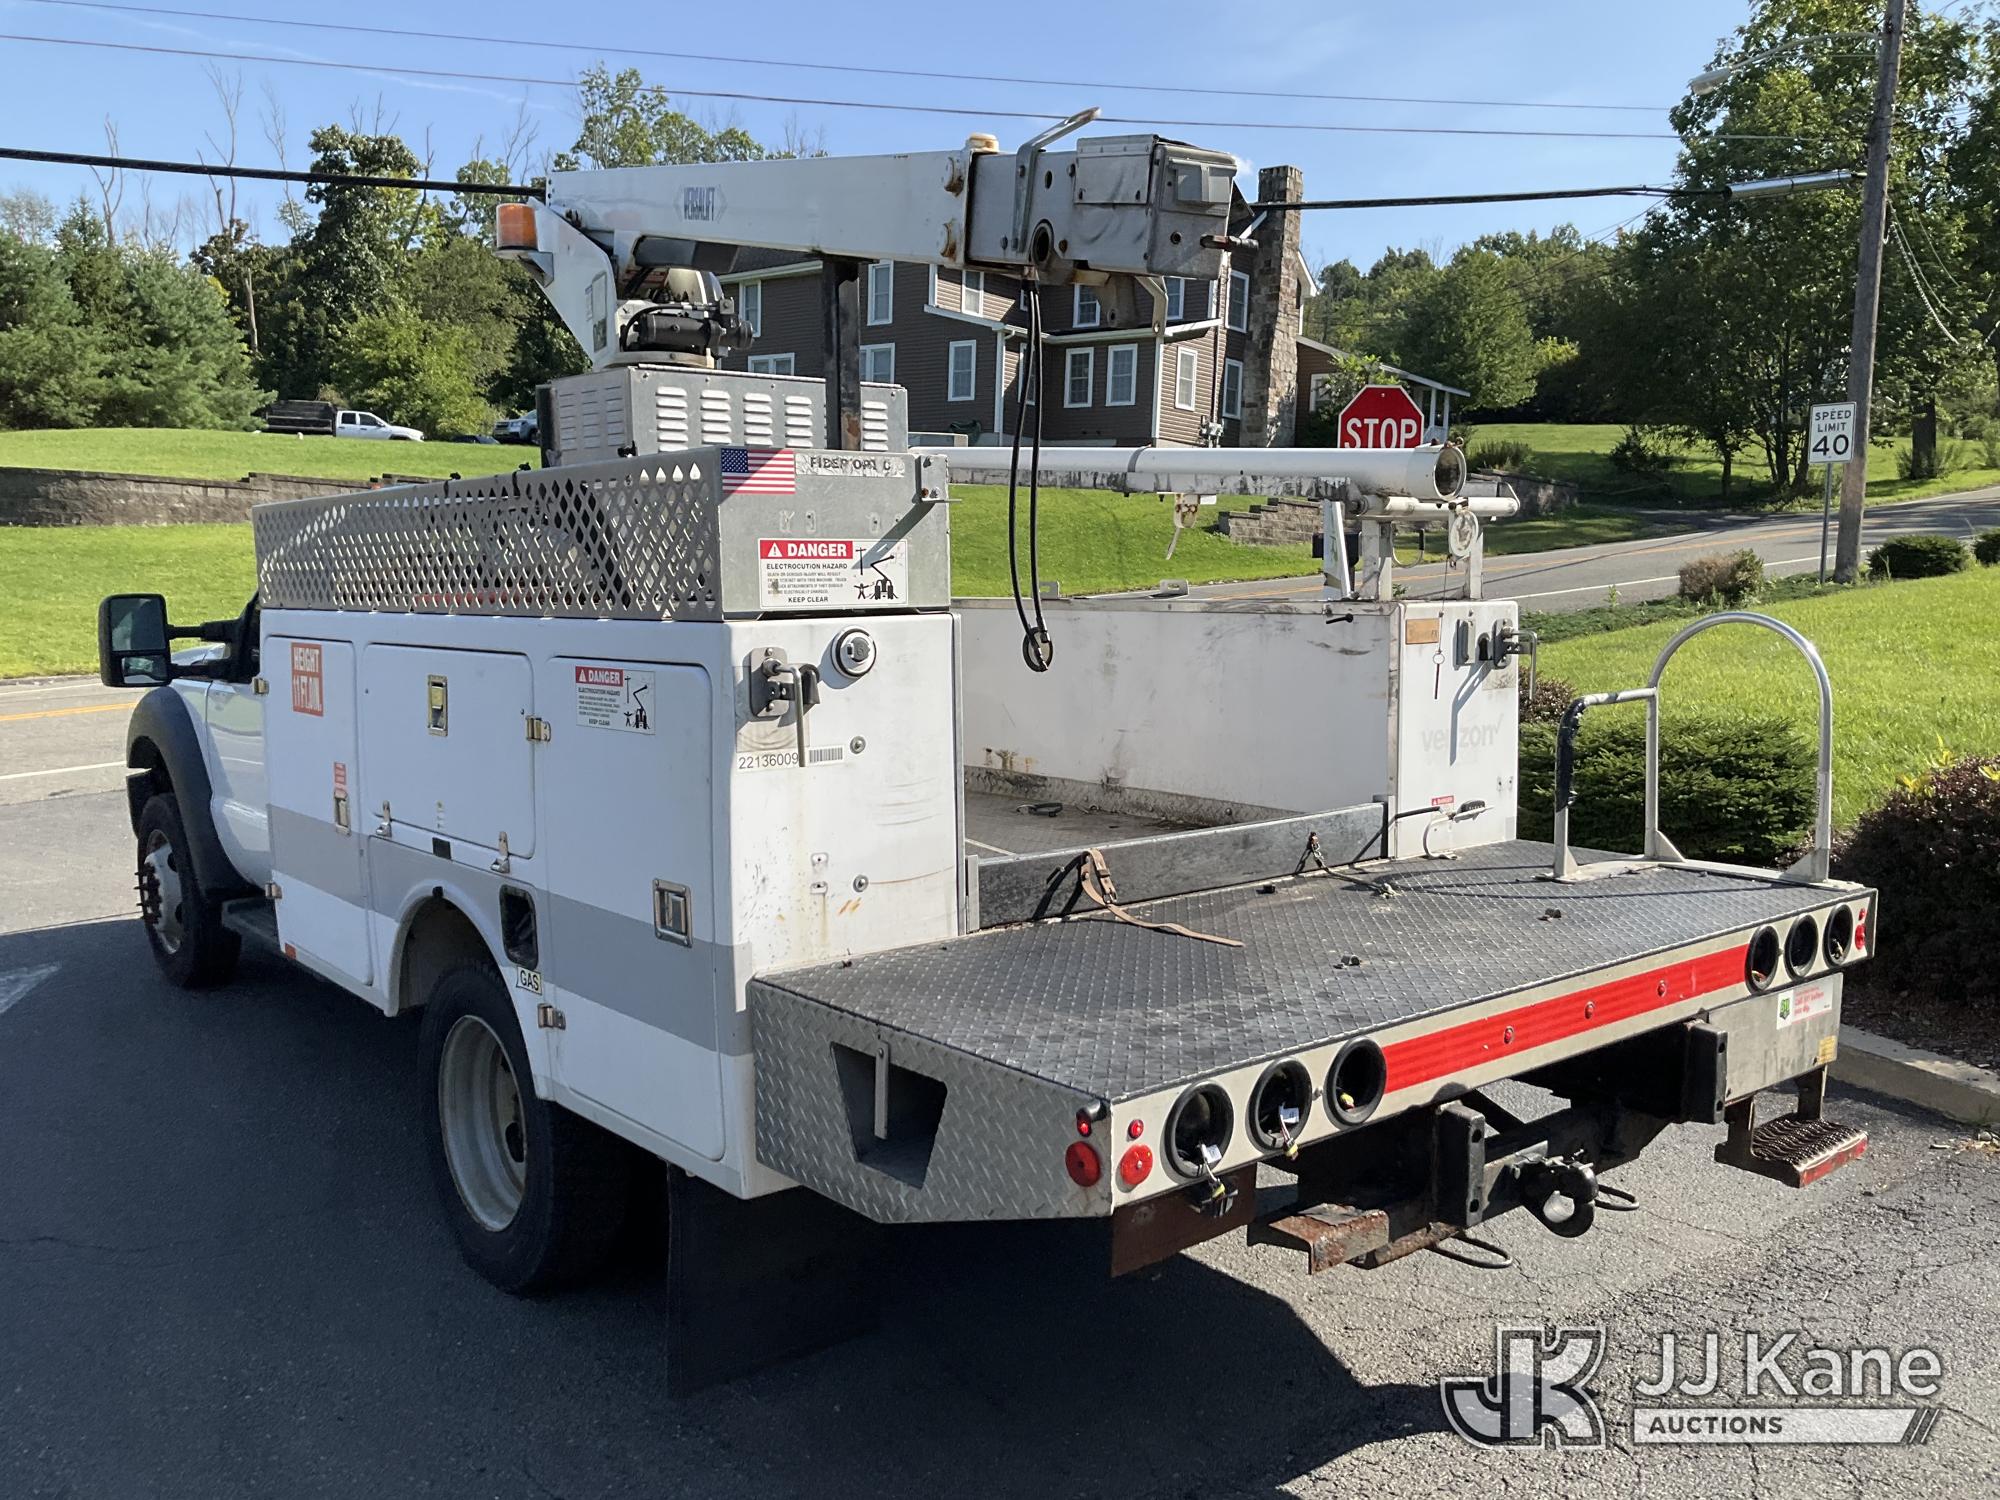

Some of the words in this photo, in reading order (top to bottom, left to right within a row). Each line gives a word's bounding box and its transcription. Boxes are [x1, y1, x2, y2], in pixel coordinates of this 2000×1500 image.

[1815, 410, 1851, 421] SPEED
[1344, 418, 1417, 448] STOP
[1817, 422, 1847, 432] LIMIT
[1812, 434, 1849, 456] 40
[787, 543, 847, 557] DANGER
[293, 647, 320, 672] HEIGHT
[588, 670, 620, 684] DANGER
[1421, 724, 1494, 752] verzon
[738, 752, 799, 769] 22136009
[520, 970, 539, 991] GAS
